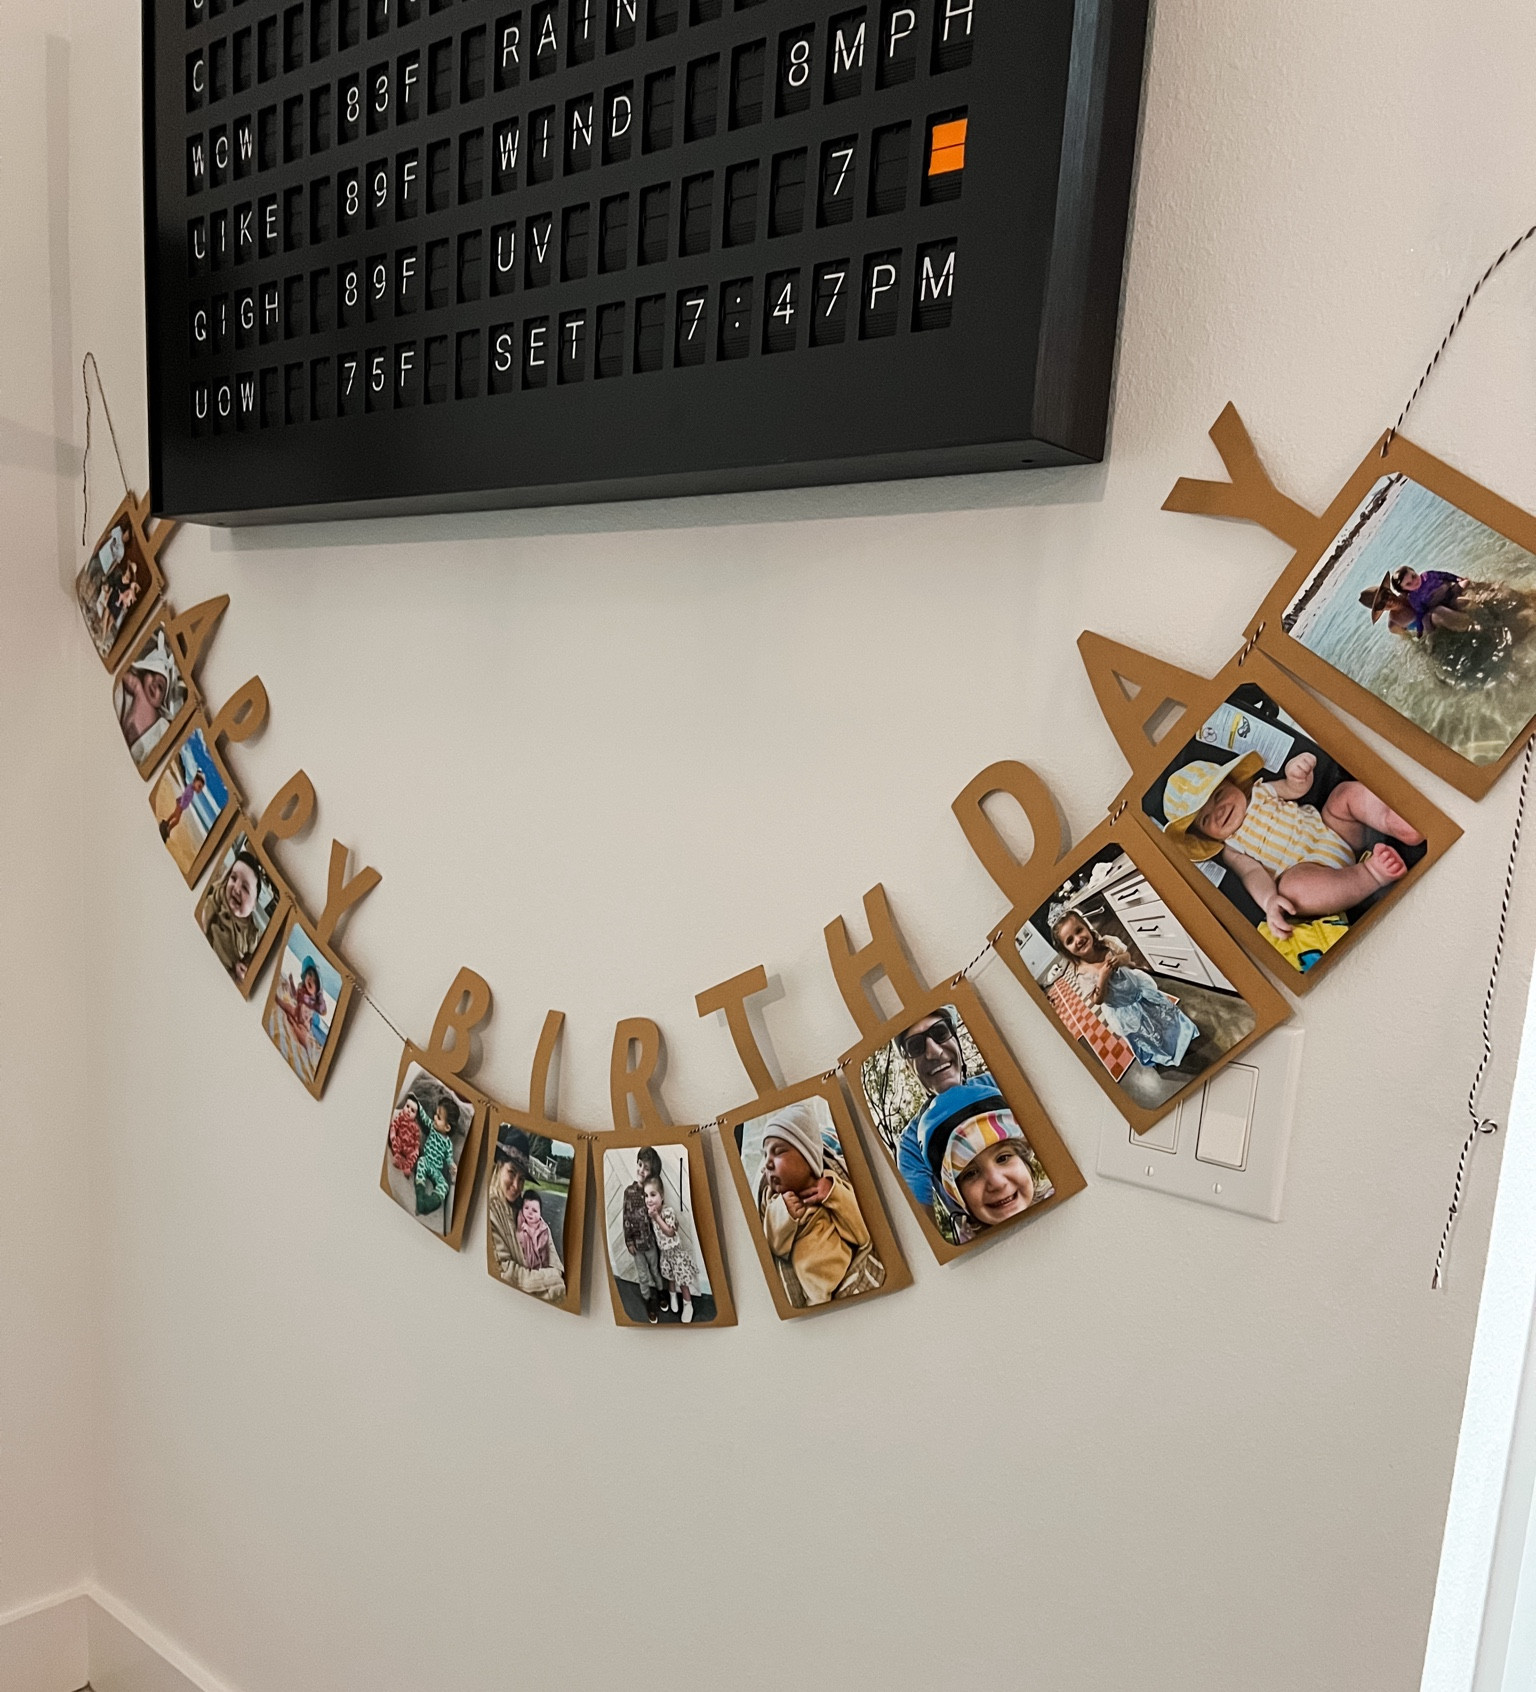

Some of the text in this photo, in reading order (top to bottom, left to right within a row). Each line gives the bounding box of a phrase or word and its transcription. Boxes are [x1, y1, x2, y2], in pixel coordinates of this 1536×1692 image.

[345, 161, 418, 216] 89F
[499, 95, 632, 171] WIND
[788, 0, 974, 87] 8MPH
[346, 63, 419, 122] 83F
[345, 257, 417, 306] 89F
[497, 223, 553, 272] UV
[831, 148, 854, 196] 7
[344, 351, 415, 396] 75F
[494, 320, 585, 372] SET
[685, 251, 956, 341] 7:47PM
[428, 401, 1322, 1130] BIRTHDAY
